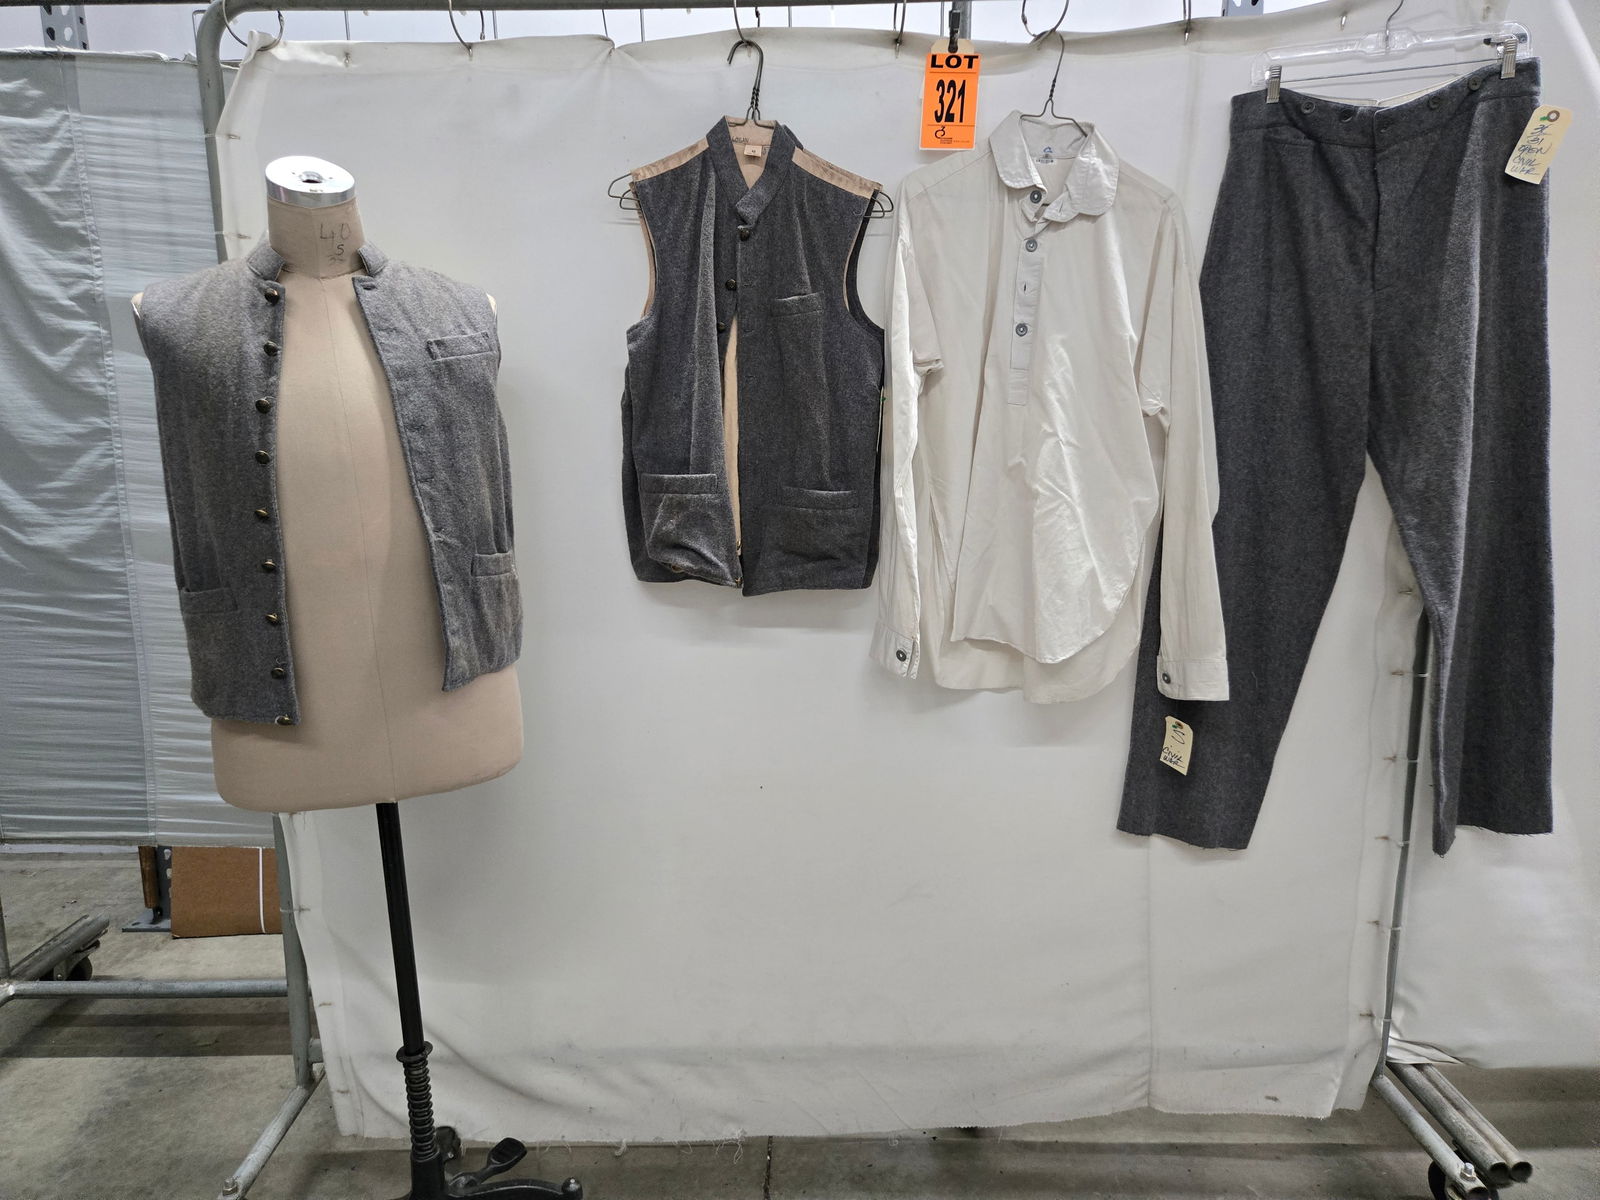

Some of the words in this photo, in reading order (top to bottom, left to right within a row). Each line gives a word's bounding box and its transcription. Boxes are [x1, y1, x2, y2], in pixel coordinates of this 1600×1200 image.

[930, 54, 979, 69] LOT
[934, 79, 966, 123] 321
[1512, 156, 1542, 167] CIVIL
[319, 222, 351, 248] 40
[1162, 746, 1184, 763] CIVIL
